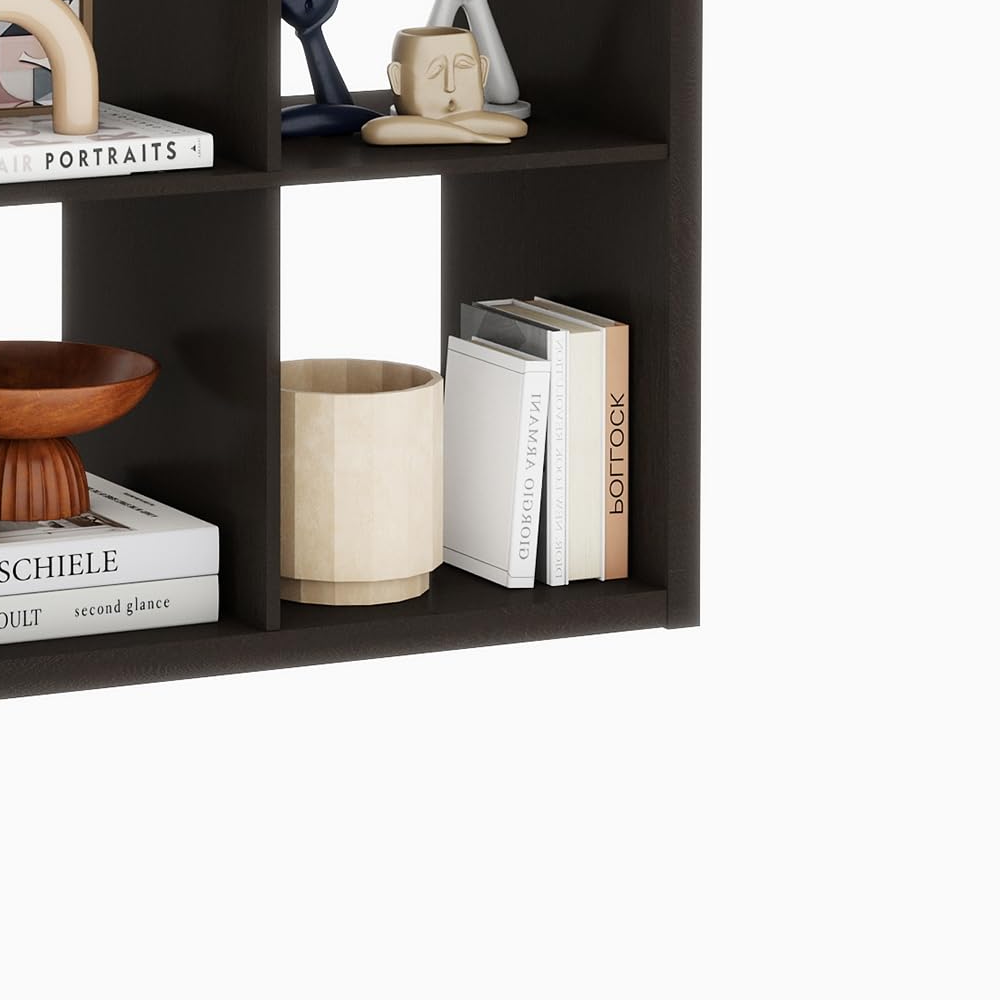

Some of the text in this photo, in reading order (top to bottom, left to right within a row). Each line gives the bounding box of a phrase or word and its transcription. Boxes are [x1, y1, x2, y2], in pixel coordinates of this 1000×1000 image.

[45, 140, 178, 170] PORTRAITS
[74, 596, 171, 618] second glance
